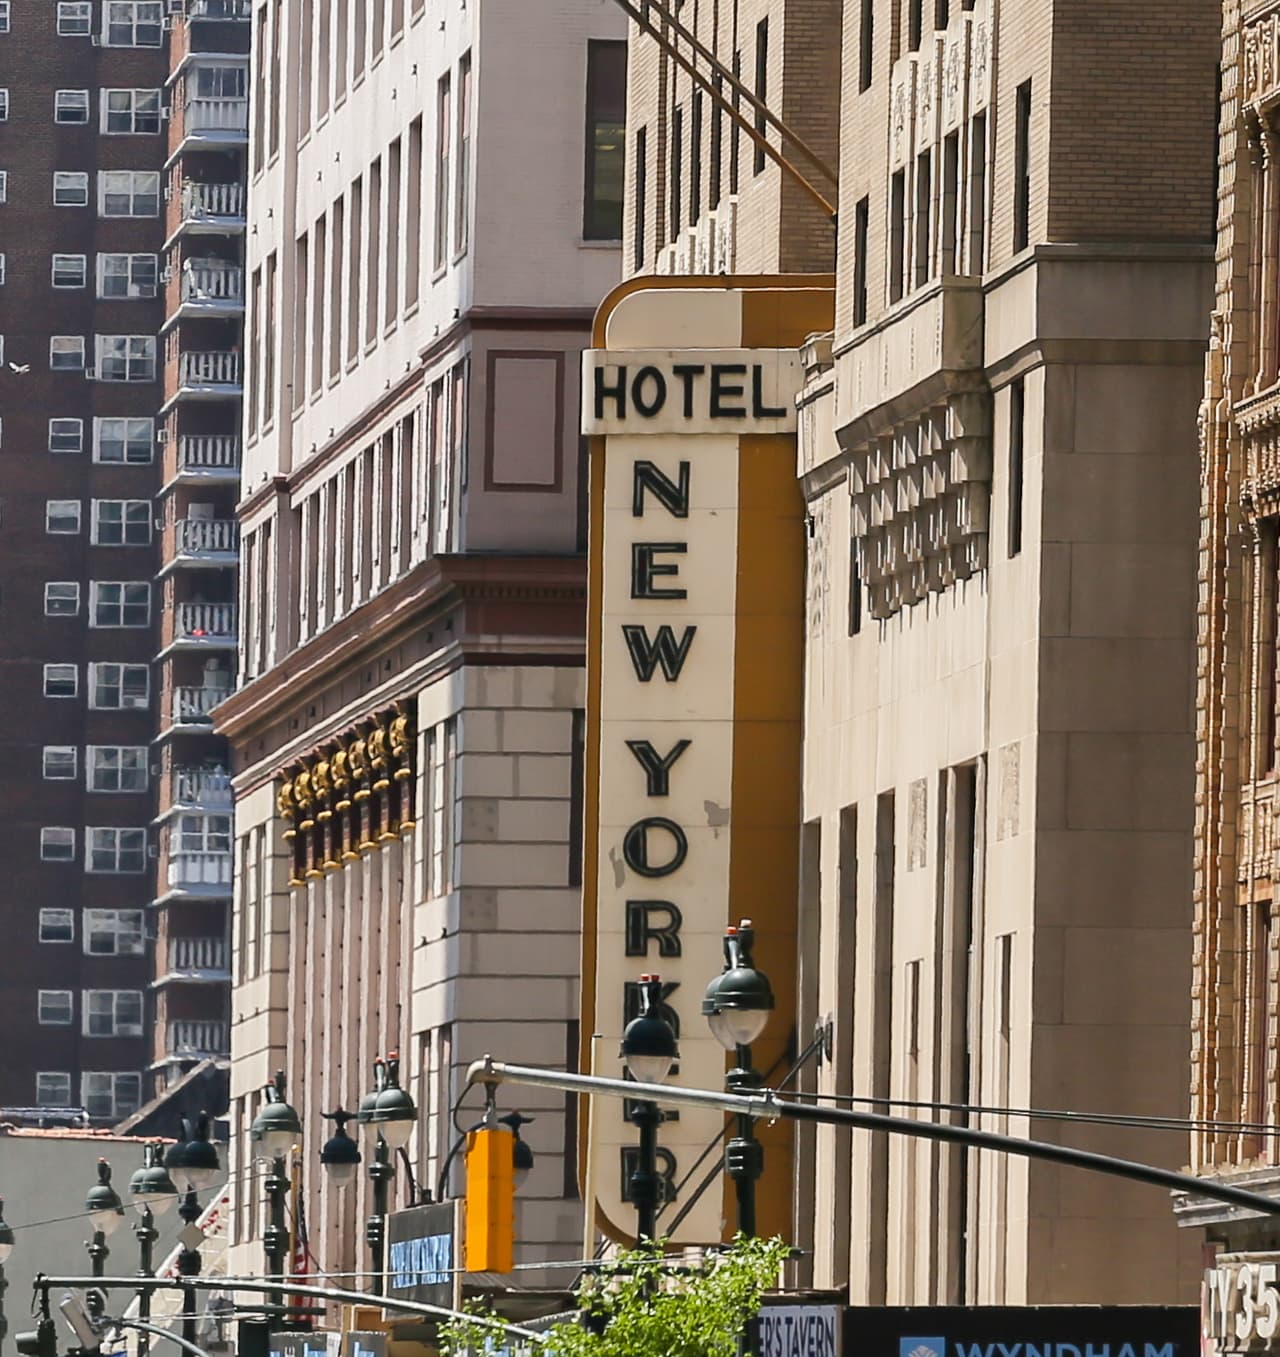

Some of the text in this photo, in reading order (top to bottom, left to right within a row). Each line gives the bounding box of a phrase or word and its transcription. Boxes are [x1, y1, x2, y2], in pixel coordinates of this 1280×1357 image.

[594, 362, 787, 420] HOTEL
[621, 458, 697, 684] NEW
[1235, 1263, 1279, 1340] 35
